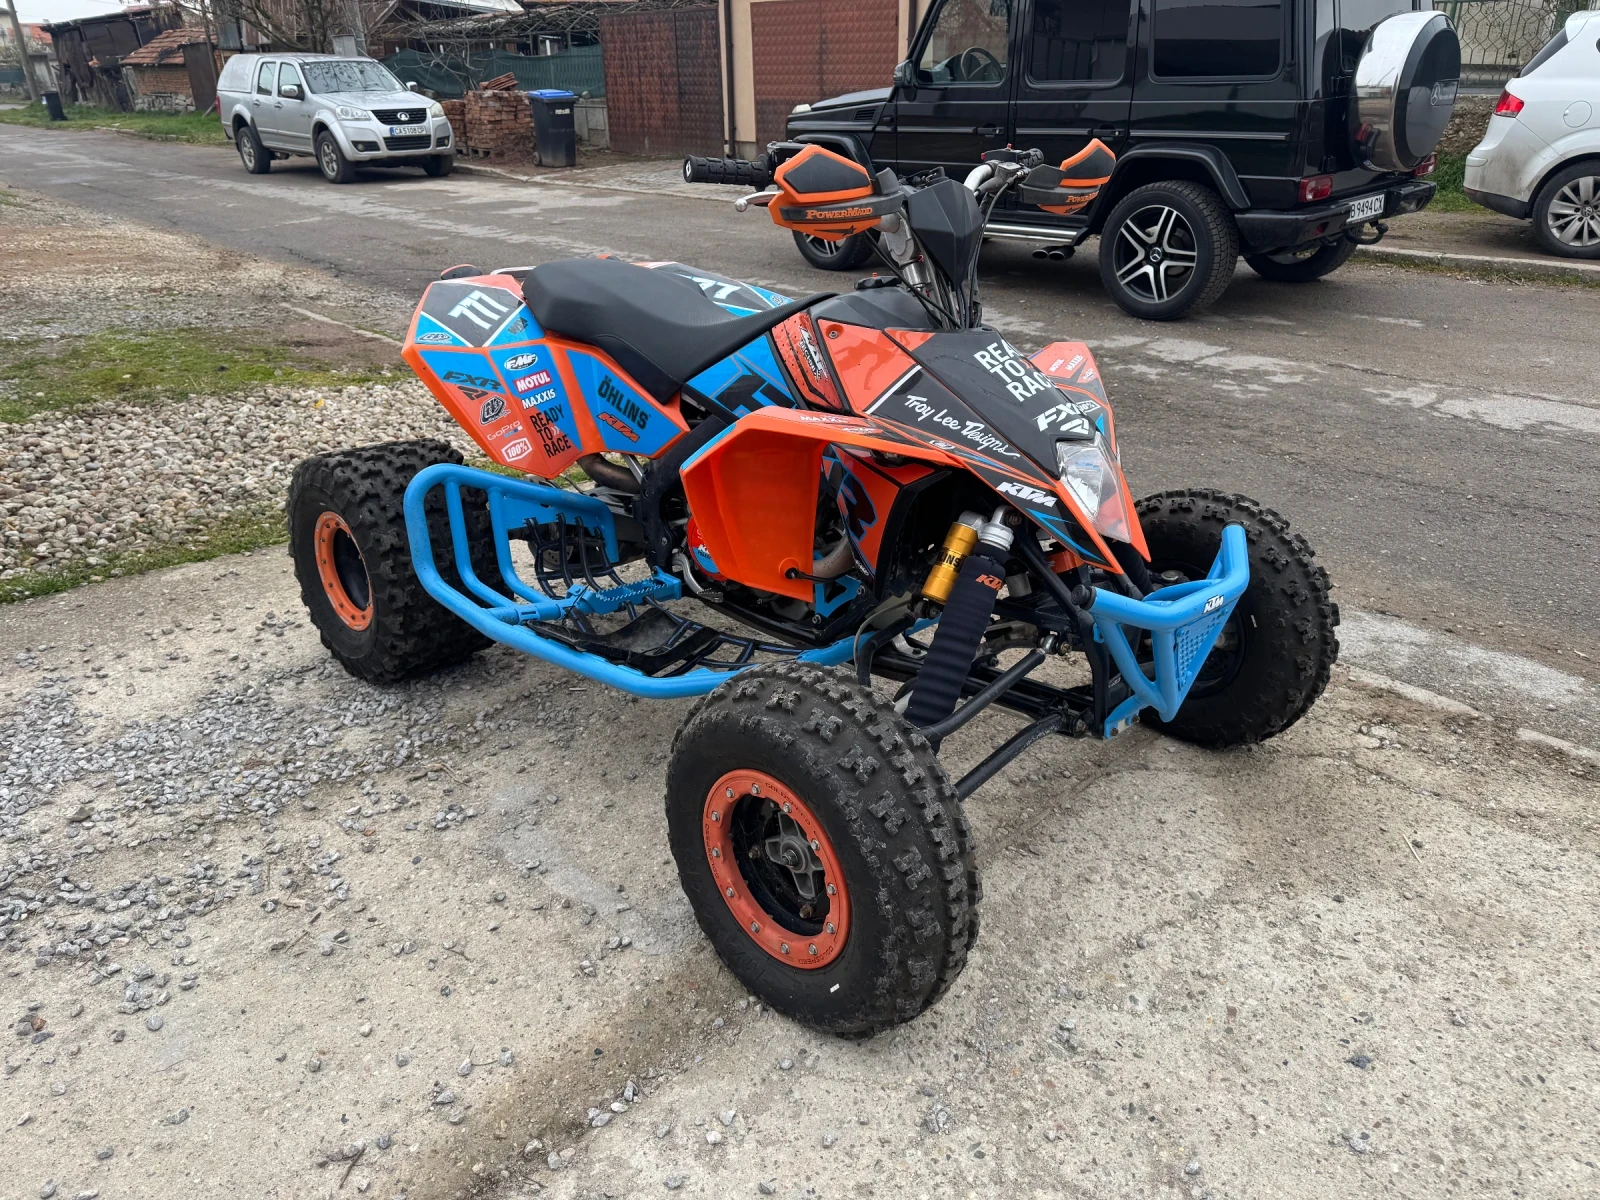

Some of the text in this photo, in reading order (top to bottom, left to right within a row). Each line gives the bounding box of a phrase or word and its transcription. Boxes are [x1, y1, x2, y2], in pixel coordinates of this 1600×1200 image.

[505, 354, 537, 370] FMF
[990, 360, 1026, 384] TO
[515, 371, 551, 393] MOTUL
[521, 388, 556, 410] MAXXIS
[597, 374, 649, 430] ÖHLINS
[529, 404, 565, 430] READY
[596, 411, 641, 444] KTM
[904, 394, 1021, 458] Troy Lee Designs
[487, 420, 521, 441] GoPro
[537, 426, 554, 444] TO
[507, 441, 528, 459] 100%
[542, 434, 572, 459] RACE
[995, 481, 1058, 508] KTM
[1202, 595, 1224, 614] KTM
